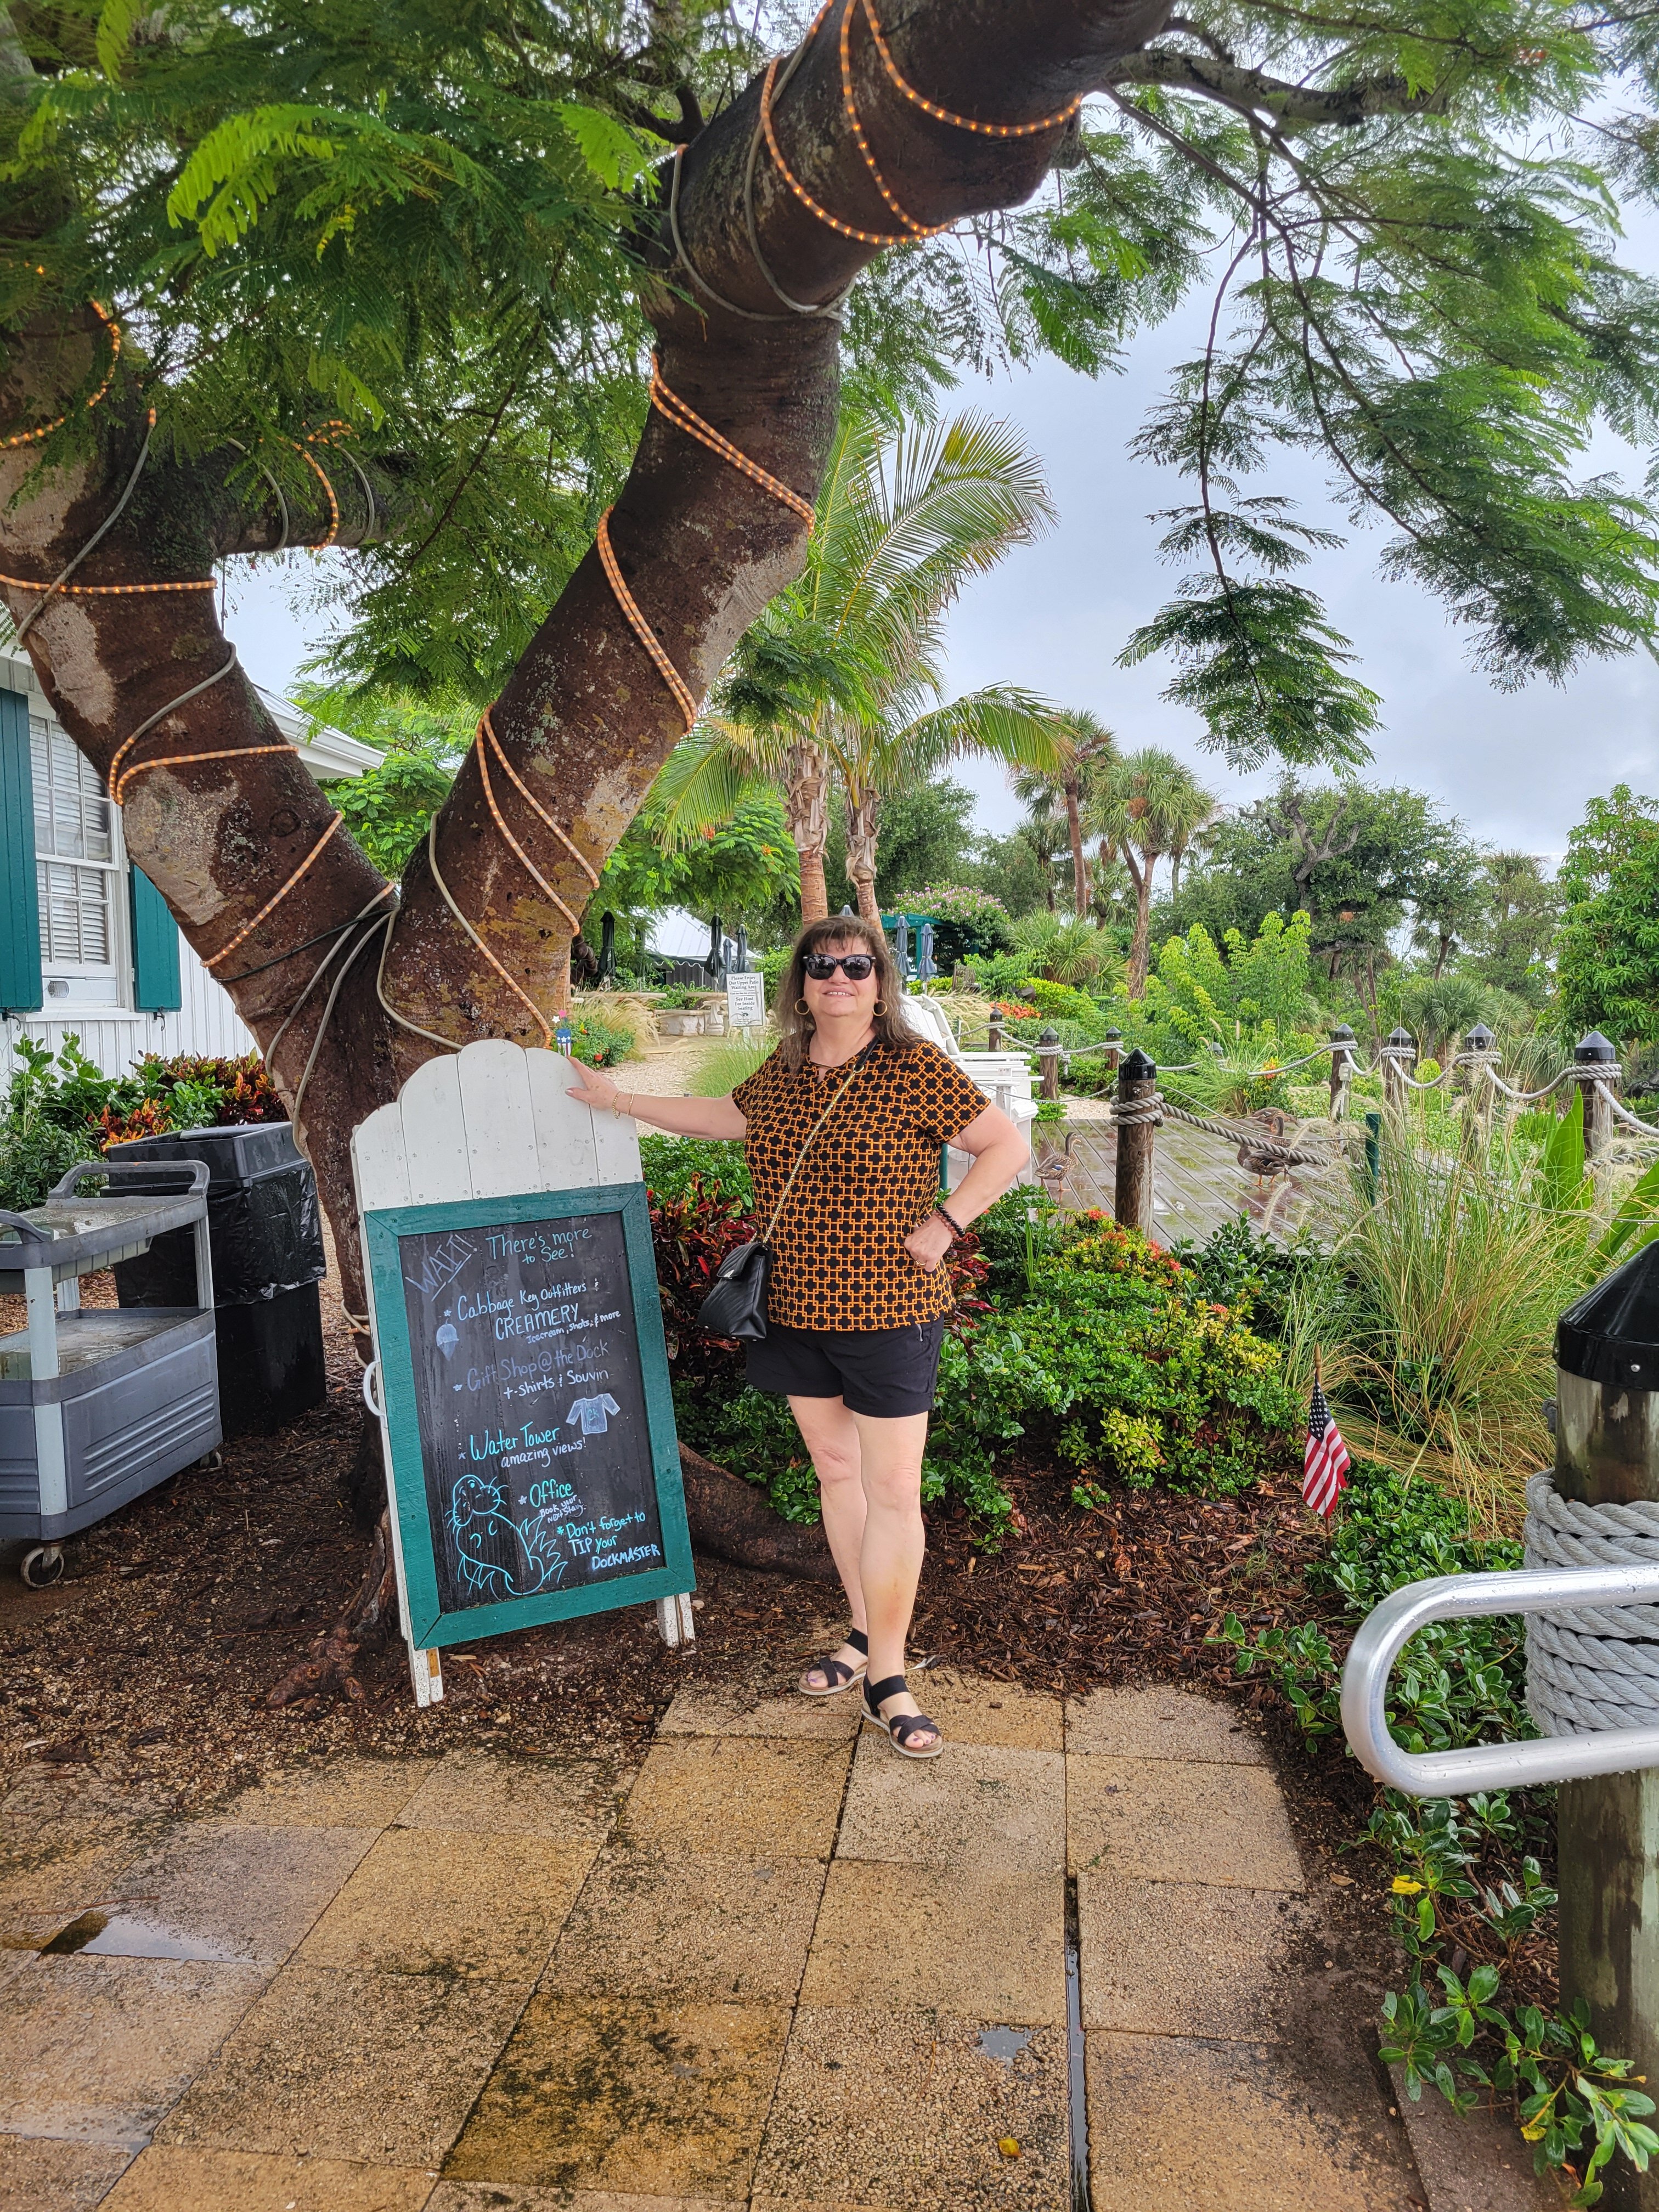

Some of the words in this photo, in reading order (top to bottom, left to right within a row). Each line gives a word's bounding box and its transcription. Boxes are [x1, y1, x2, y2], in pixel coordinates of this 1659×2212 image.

[486, 1231, 546, 1260] There's
[552, 1227, 592, 1246] more
[522, 1254, 535, 1264] to
[540, 1242, 575, 1262] See!
[457, 1290, 515, 1321] Cabbage
[520, 1289, 539, 1311] Key
[540, 1282, 587, 1301] Outfitters
[495, 1302, 579, 1341] CREAMERY
[600, 1310, 622, 1323] more
[467, 1362, 497, 1392] Gift
[554, 1348, 573, 1368] the
[576, 1338, 611, 1362] Dock
[503, 1374, 555, 1400] t-shirts
[470, 1428, 518, 1461] Water
[520, 1421, 560, 1448] Tower
[501, 1447, 551, 1468] amazing
[552, 1436, 586, 1457] views!
[529, 1479, 574, 1508] Office
[560, 1494, 578, 1510] your
[566, 1520, 596, 1539] Don't
[599, 1513, 633, 1532] forget
[634, 1511, 646, 1522] to
[568, 1537, 593, 1556] TIP
[595, 1535, 618, 1554] your
[591, 1543, 661, 1571] DOCKMASTER
